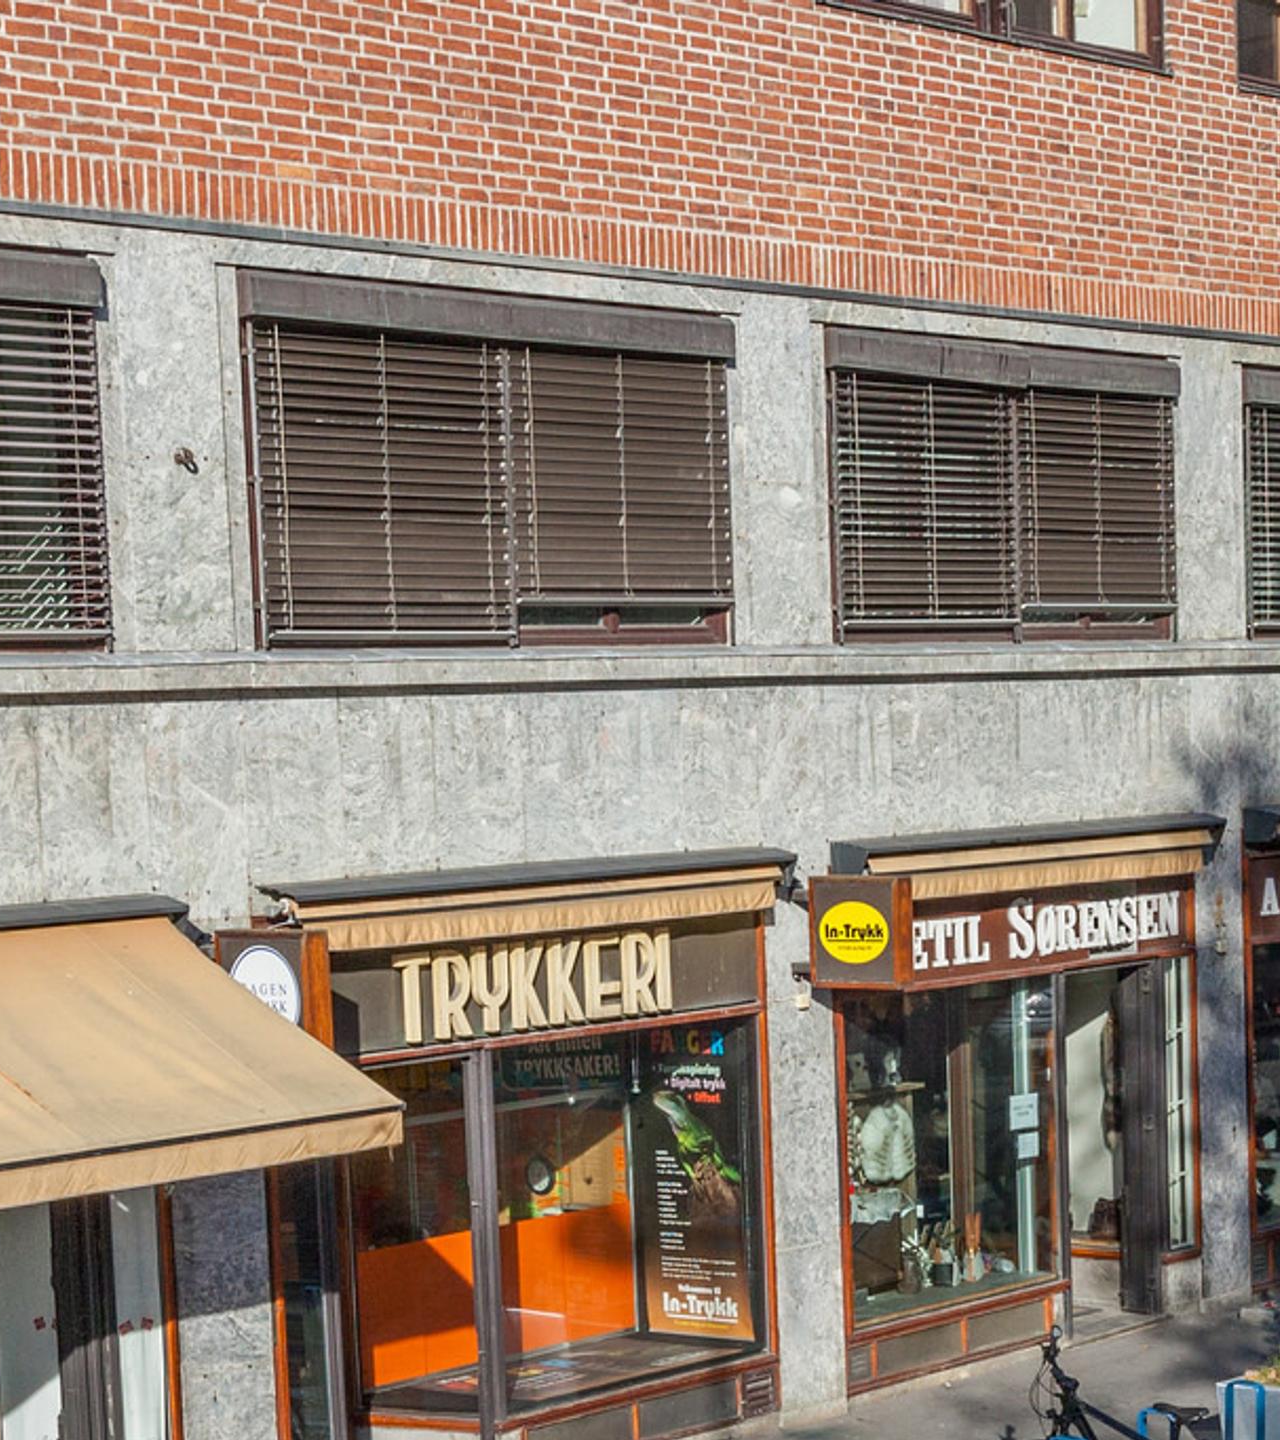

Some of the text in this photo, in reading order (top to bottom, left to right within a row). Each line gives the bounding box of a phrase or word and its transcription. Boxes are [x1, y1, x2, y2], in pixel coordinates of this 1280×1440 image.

[1260, 877, 1280, 916] A
[825, 923, 884, 942] In-Trykk
[912, 890, 1181, 970] ETIL SØRENSEN
[392, 926, 673, 1046] TRYKKERI
[662, 1291, 739, 1322] In-Trykk
